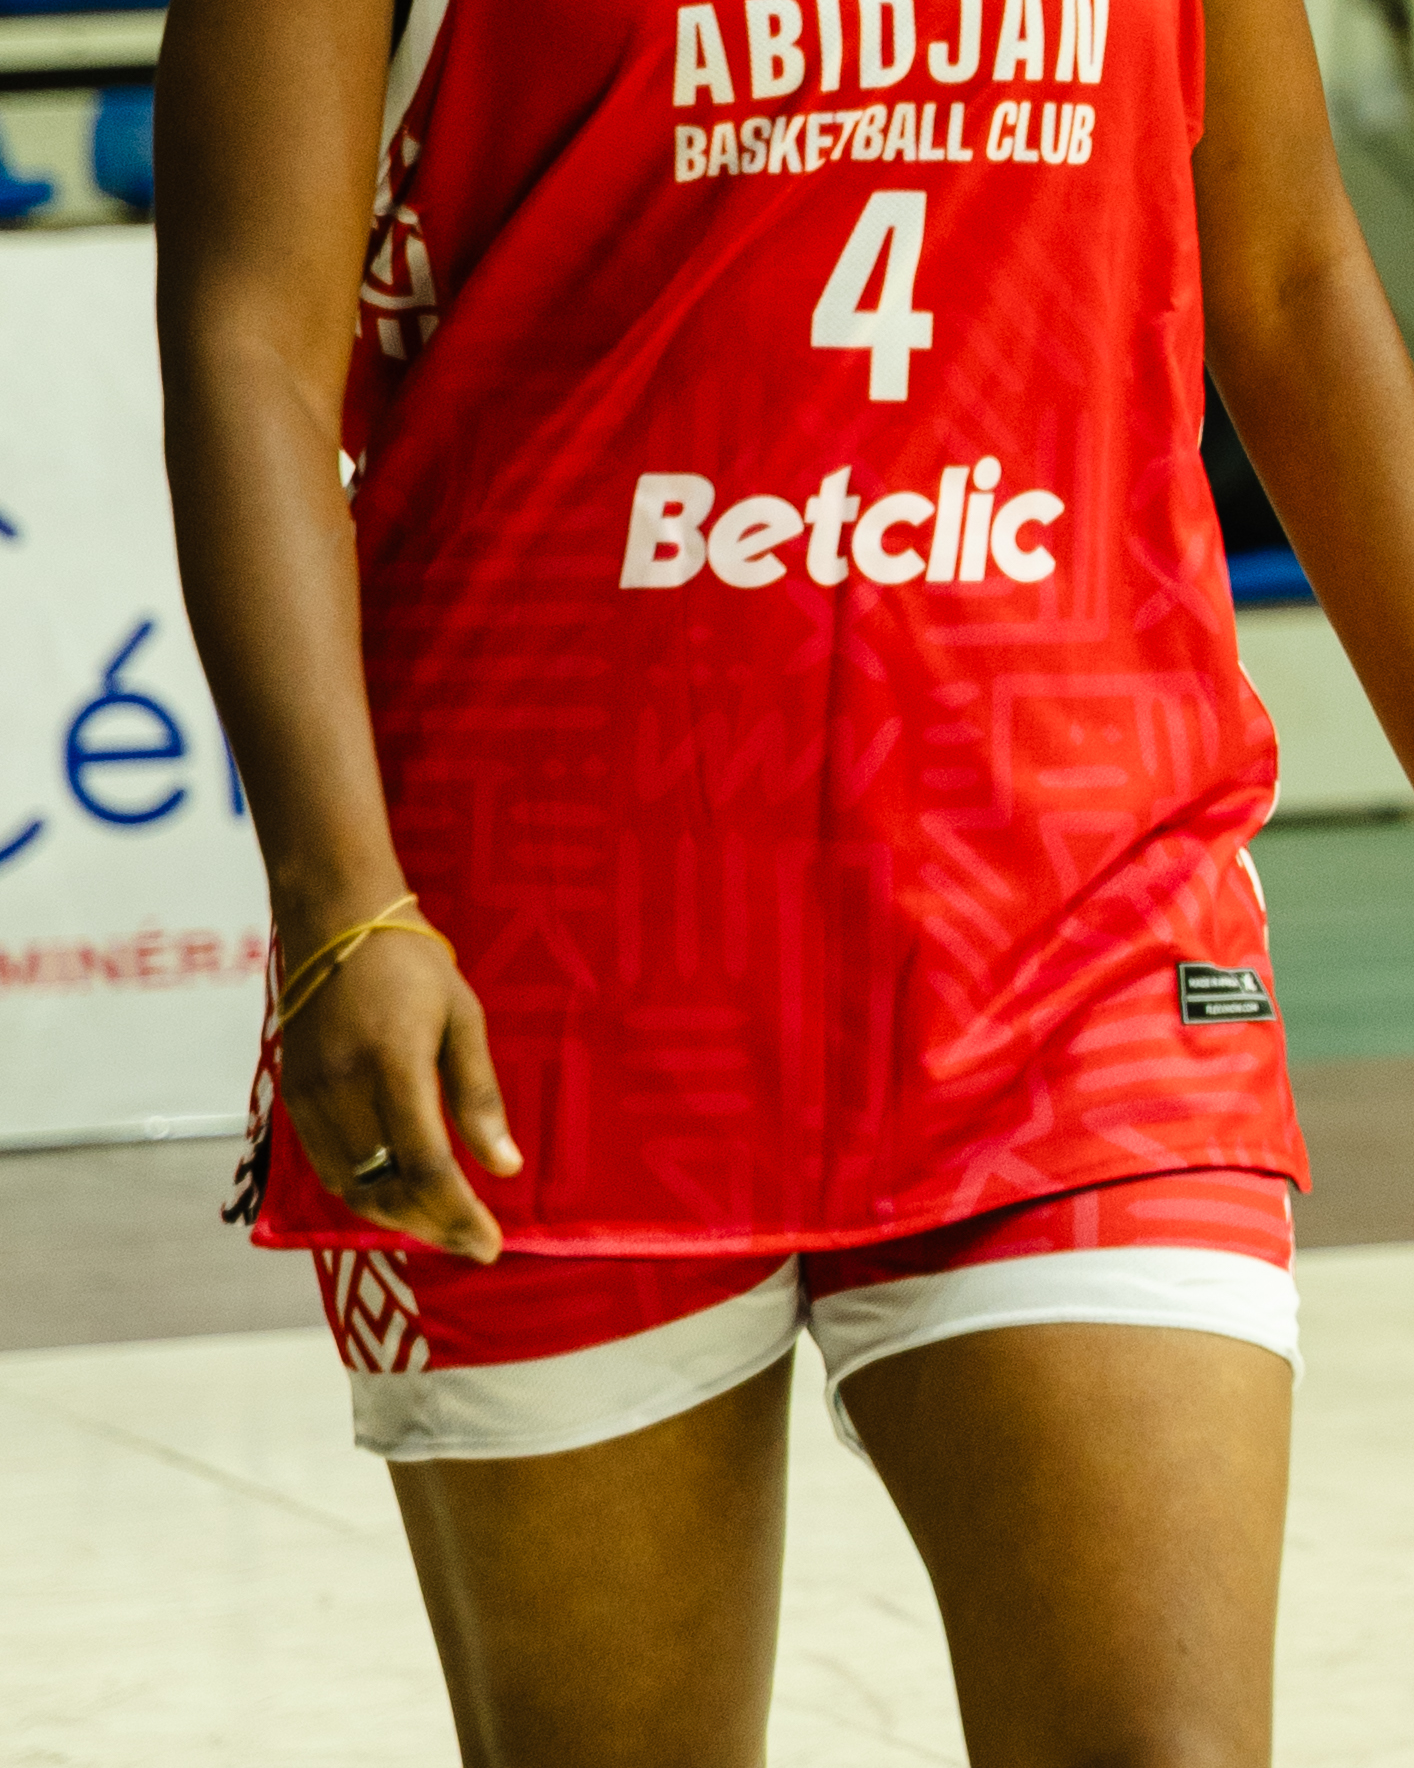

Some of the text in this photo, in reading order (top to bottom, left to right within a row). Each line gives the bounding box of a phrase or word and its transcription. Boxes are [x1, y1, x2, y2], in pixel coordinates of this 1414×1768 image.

[673, 101, 1096, 183] BASKETBALL CLUB
[810, 190, 934, 402] 4
[619, 455, 1065, 589] Betclic
[0, 917, 267, 989] MINÉRA
